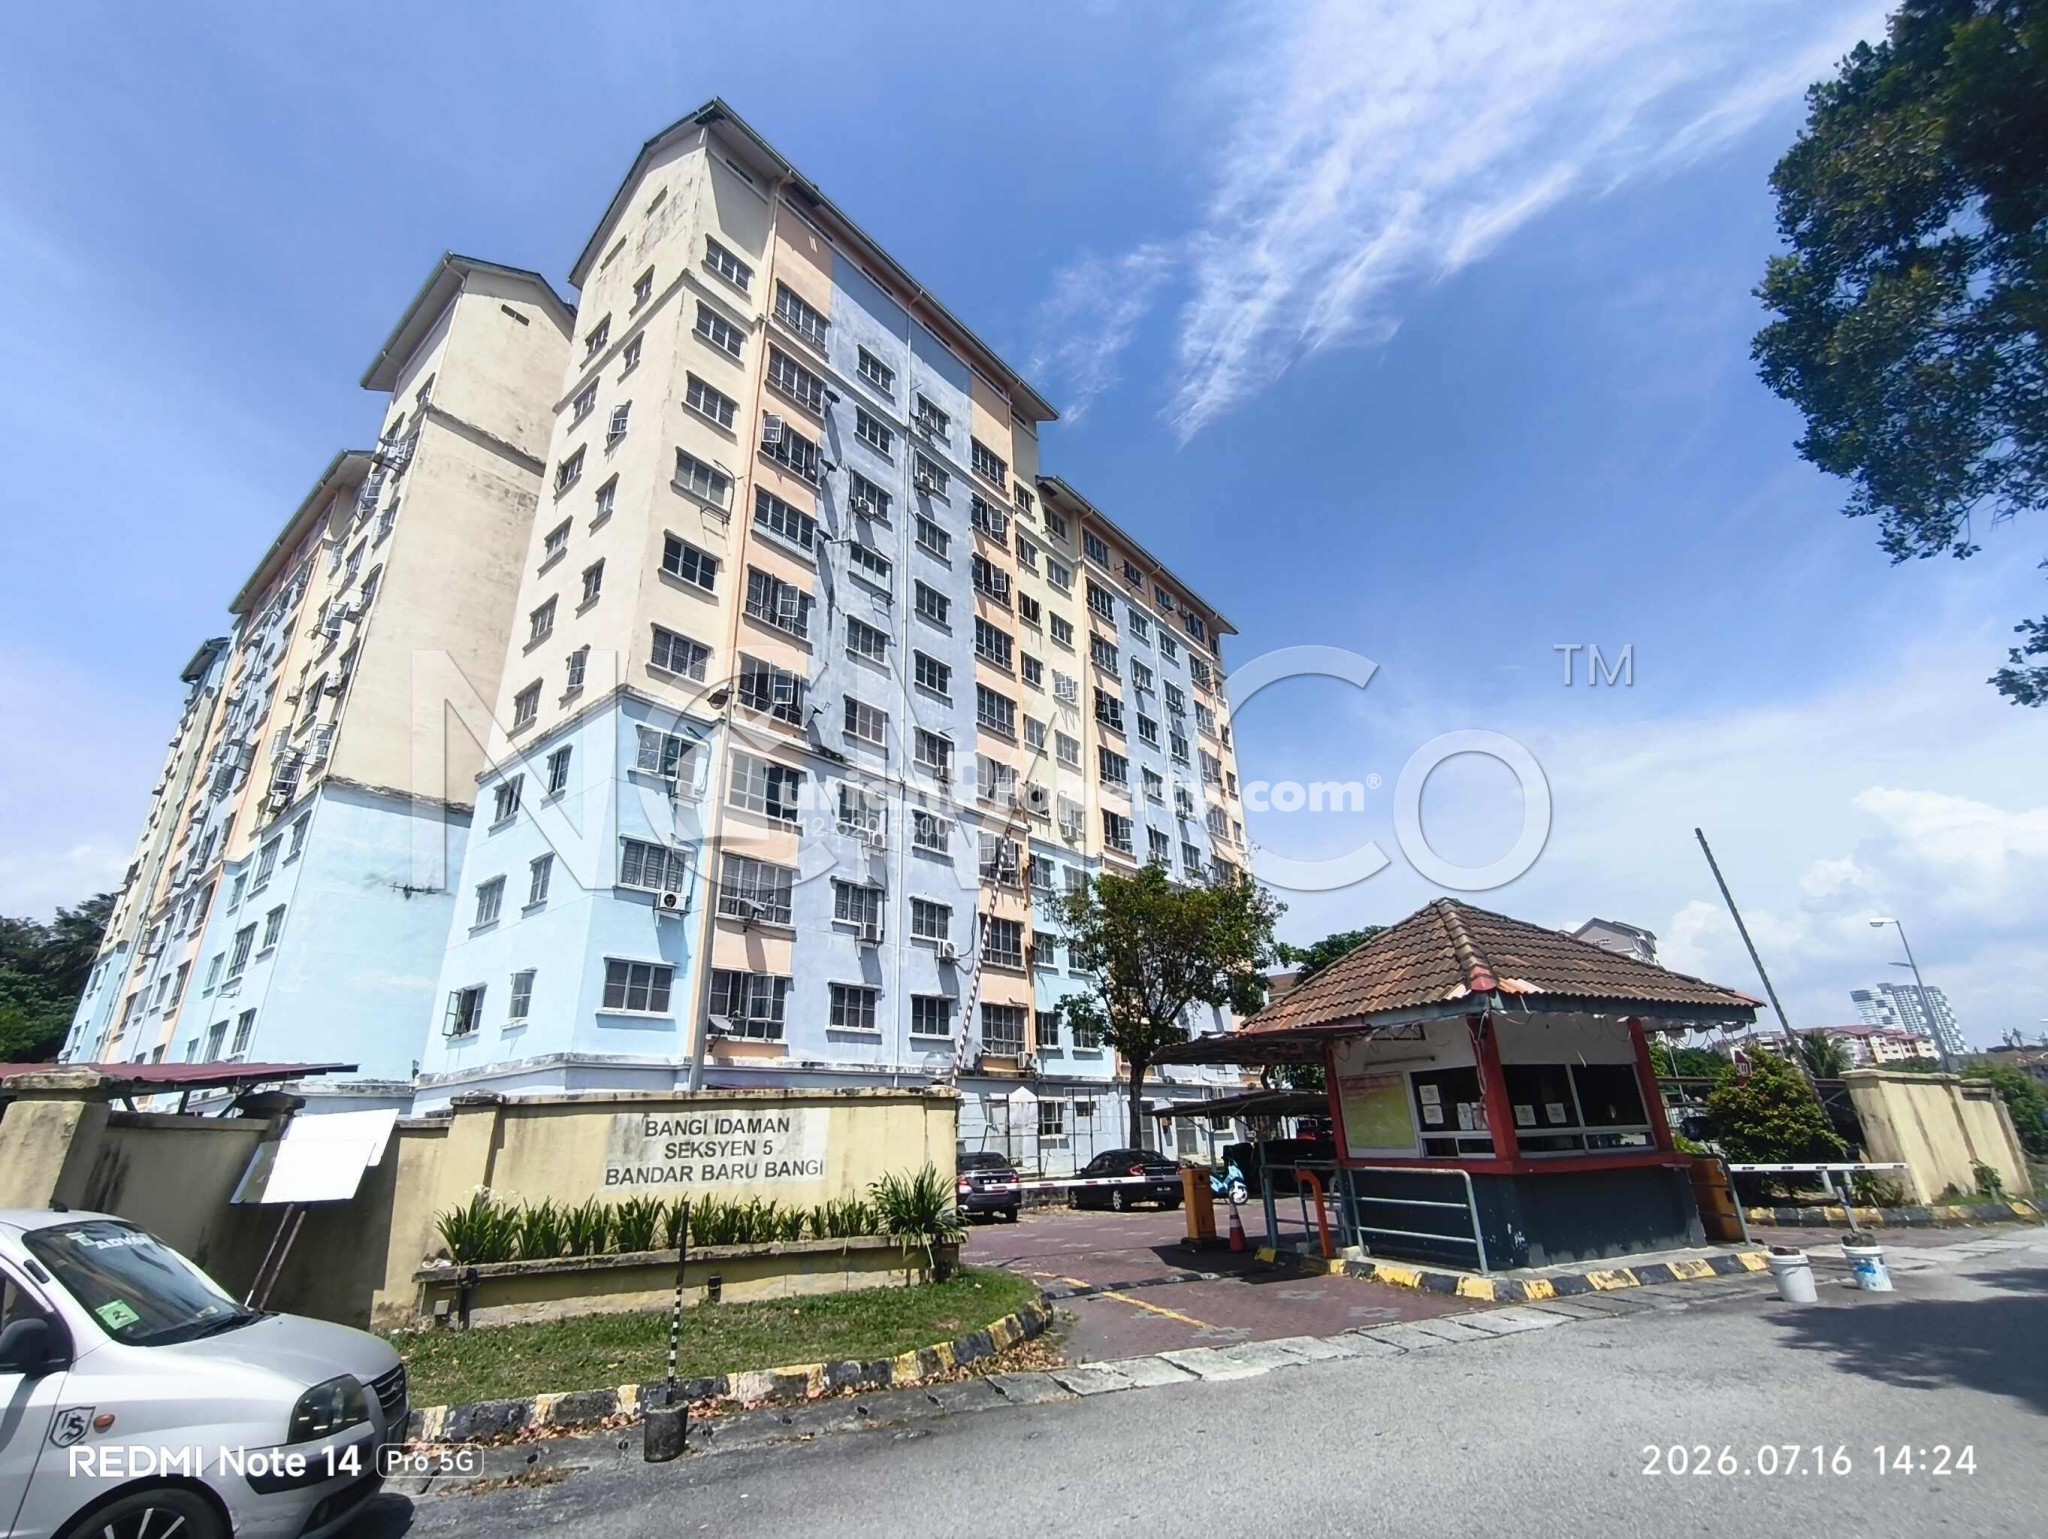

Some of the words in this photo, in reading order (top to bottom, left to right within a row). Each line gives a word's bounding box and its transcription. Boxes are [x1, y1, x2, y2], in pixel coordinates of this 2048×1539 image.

[644, 1119, 708, 1137] BANGI
[714, 1117, 790, 1136] IDAMAN
[664, 1140, 756, 1159] SEKSYEN
[763, 1139, 773, 1156] 5
[605, 1165, 694, 1186] BANDAR
[701, 1163, 758, 1181] BARU
[764, 1159, 823, 1178] BANGI
